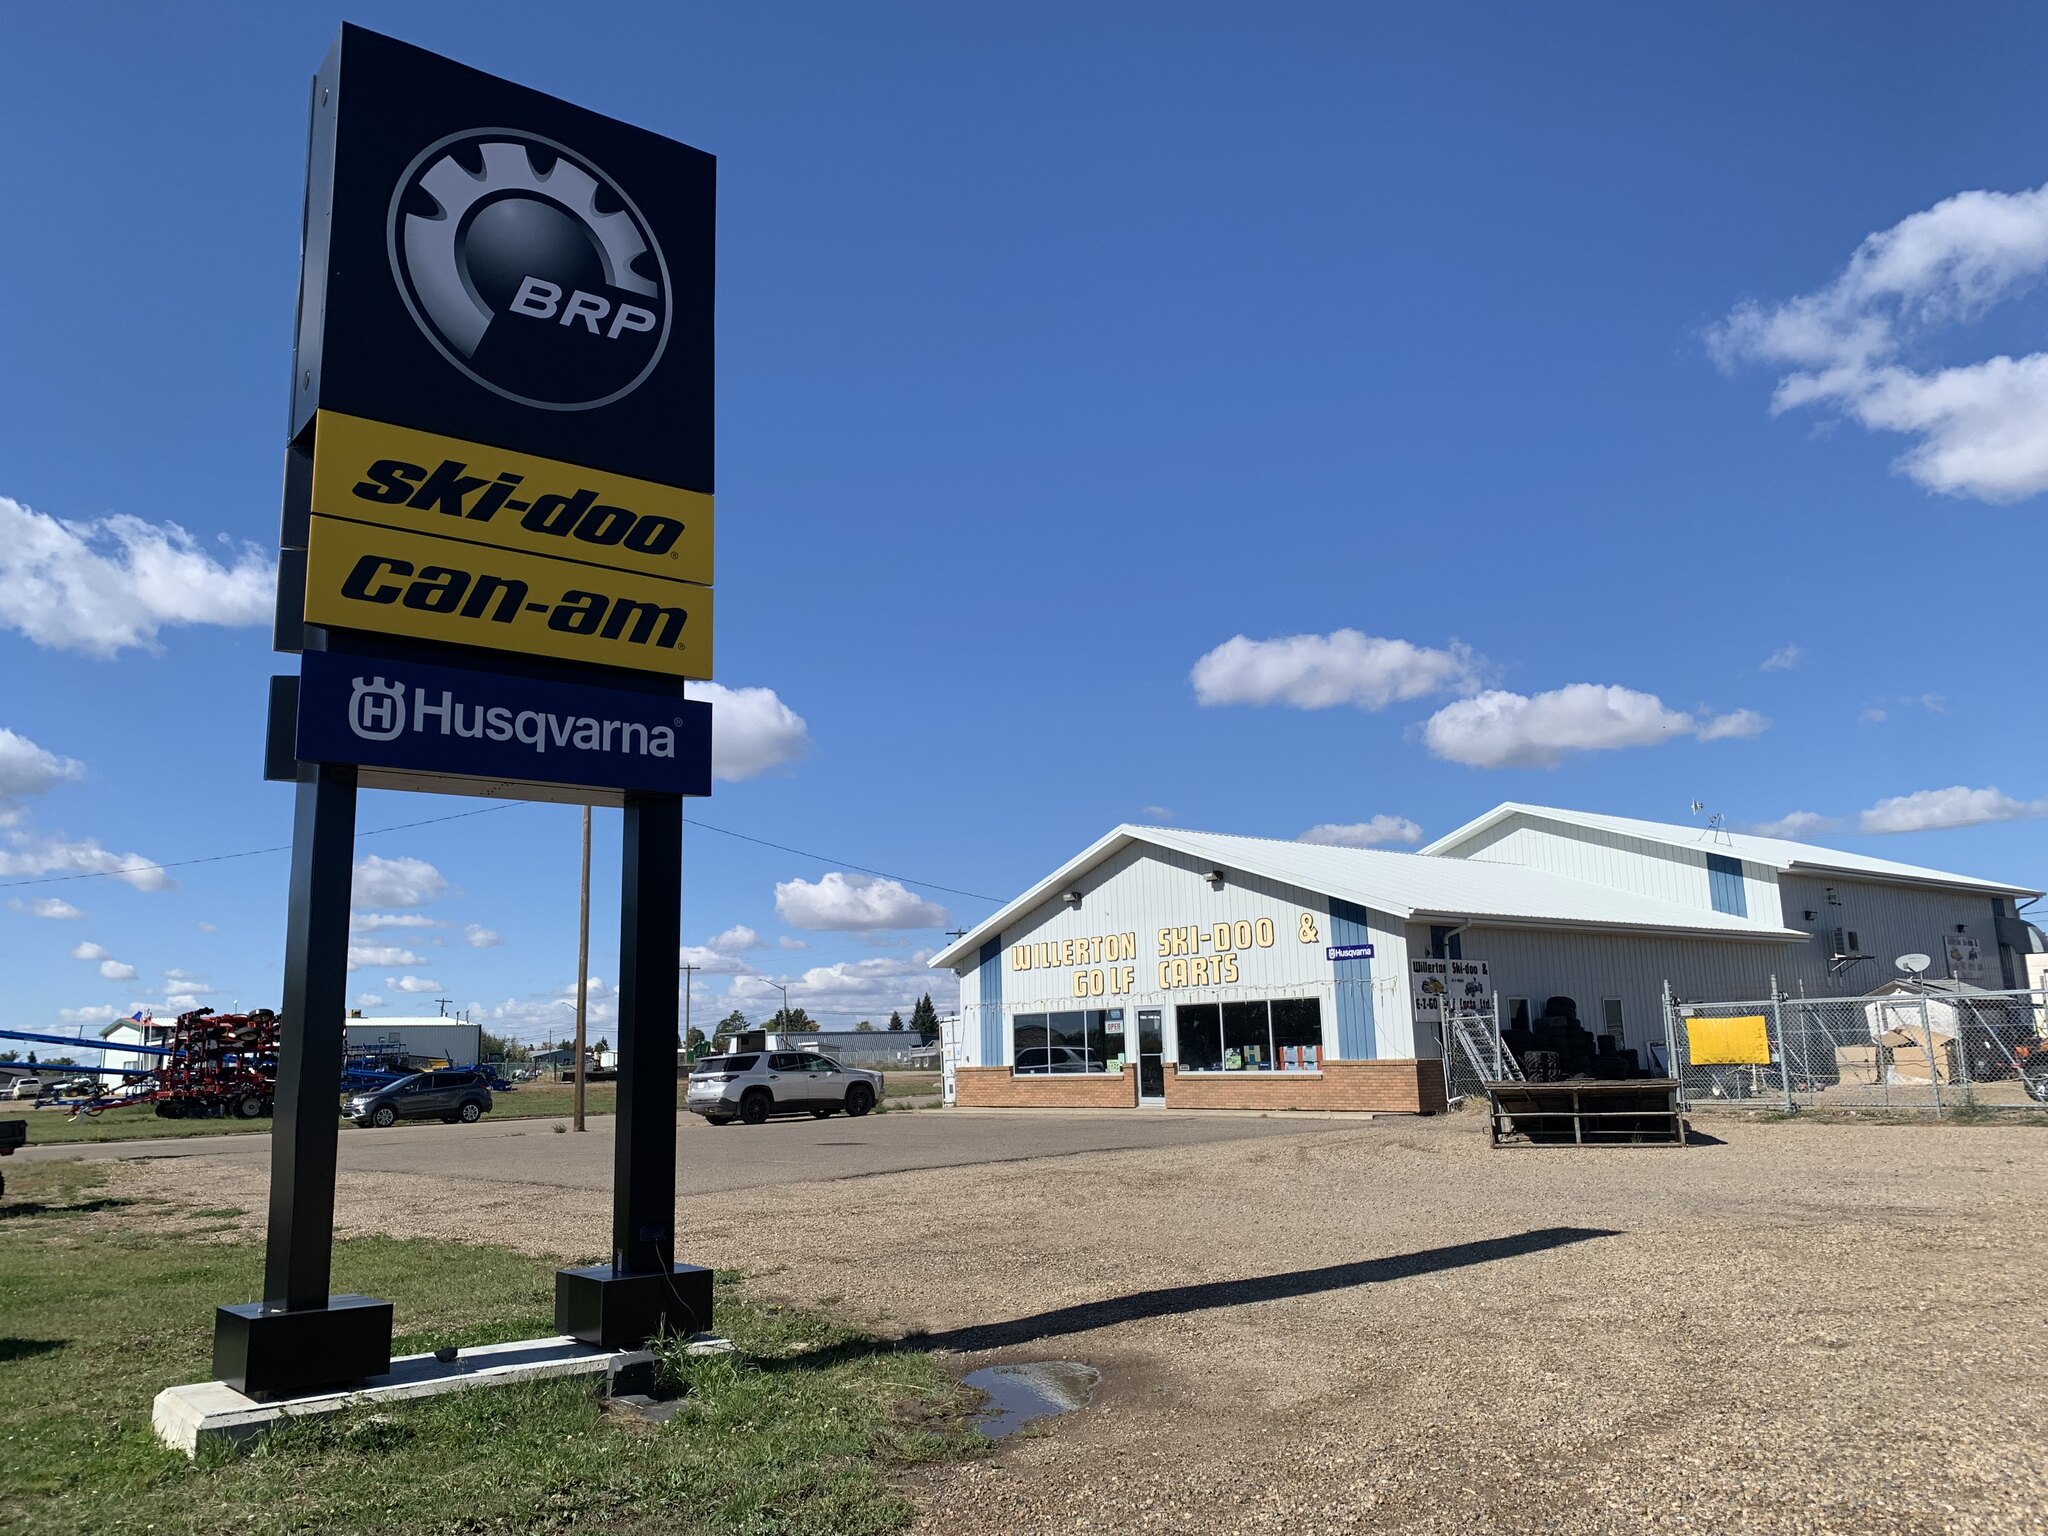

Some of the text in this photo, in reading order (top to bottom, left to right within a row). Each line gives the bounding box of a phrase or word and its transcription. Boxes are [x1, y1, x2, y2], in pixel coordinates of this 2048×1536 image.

[509, 275, 657, 340] BRP
[351, 459, 686, 556] ski-doo
[340, 554, 688, 649] can-am
[413, 687, 676, 758] Husqvarna
[1012, 912, 1320, 971] WILLERTON SKI-DOO &
[1335, 947, 1372, 958] Husqvarna
[1072, 953, 1239, 998] GOLF CARTS
